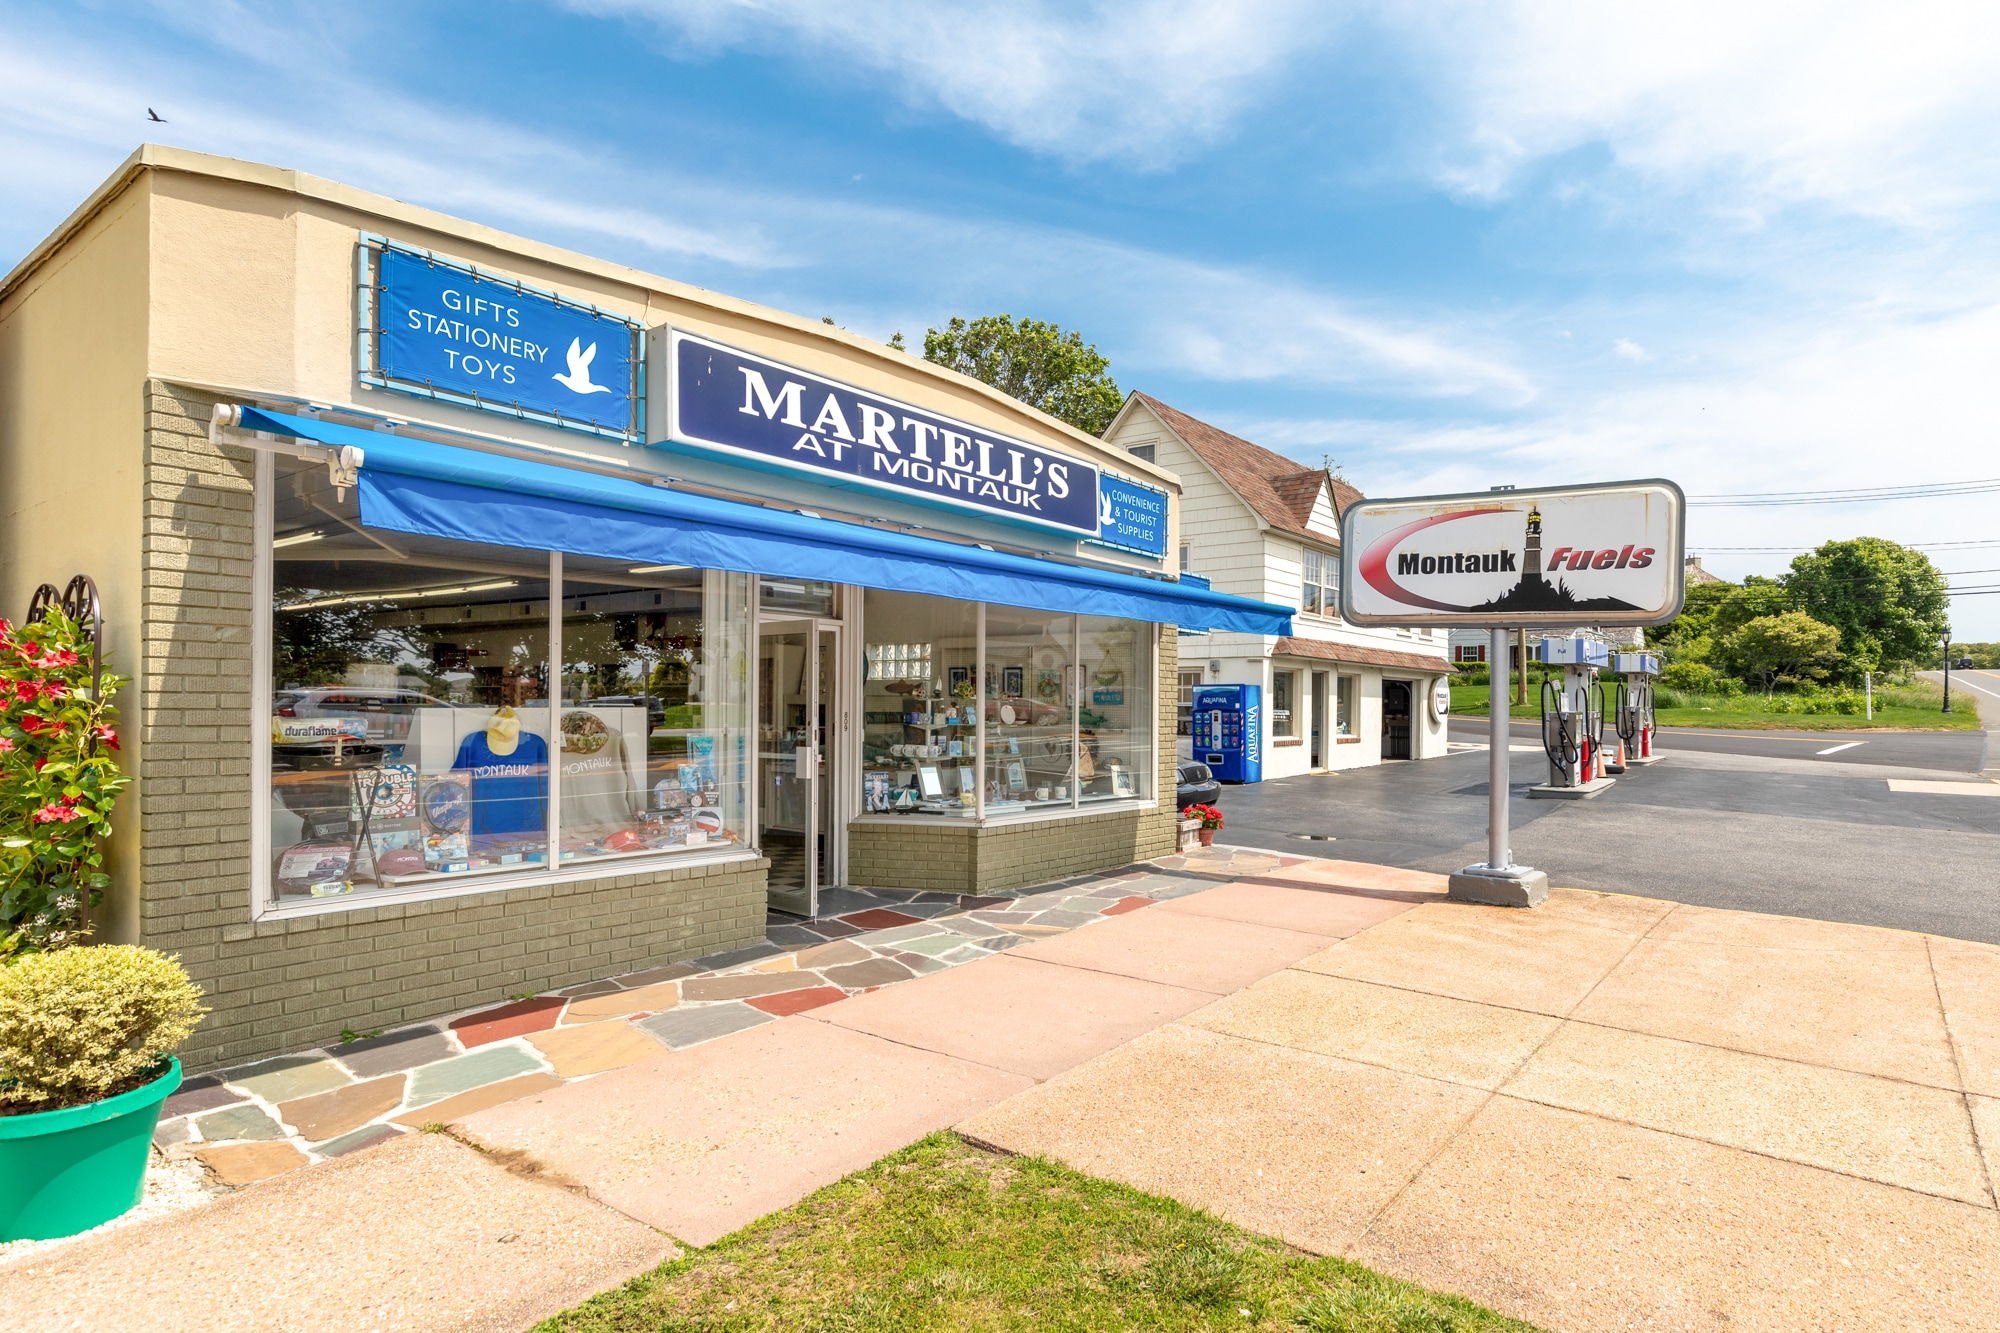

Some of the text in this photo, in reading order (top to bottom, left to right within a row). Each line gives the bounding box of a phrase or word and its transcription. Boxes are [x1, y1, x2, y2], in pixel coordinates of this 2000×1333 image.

[441, 289, 520, 328] GIFTS
[408, 309, 549, 364] STATIONERY
[443, 348, 516, 385] TOYS
[737, 366, 1070, 499] MARTELL'S
[791, 433, 1042, 511] AT MONTAUK
[1111, 489, 1160, 514] CONVENIENCE
[1114, 506, 1157, 527] & TOURIST
[1117, 522, 1154, 542] SUPPLIES
[1397, 544, 1656, 576] Montauk Fuels
[1202, 696, 1228, 705] AQUAFINA
[284, 725, 337, 737] duraflame
[1246, 704, 1259, 763] AQUAFINA
[474, 764, 529, 780] MONTAUK
[562, 756, 612, 775] MONTAUK
[358, 772, 413, 788] TROUBLE
